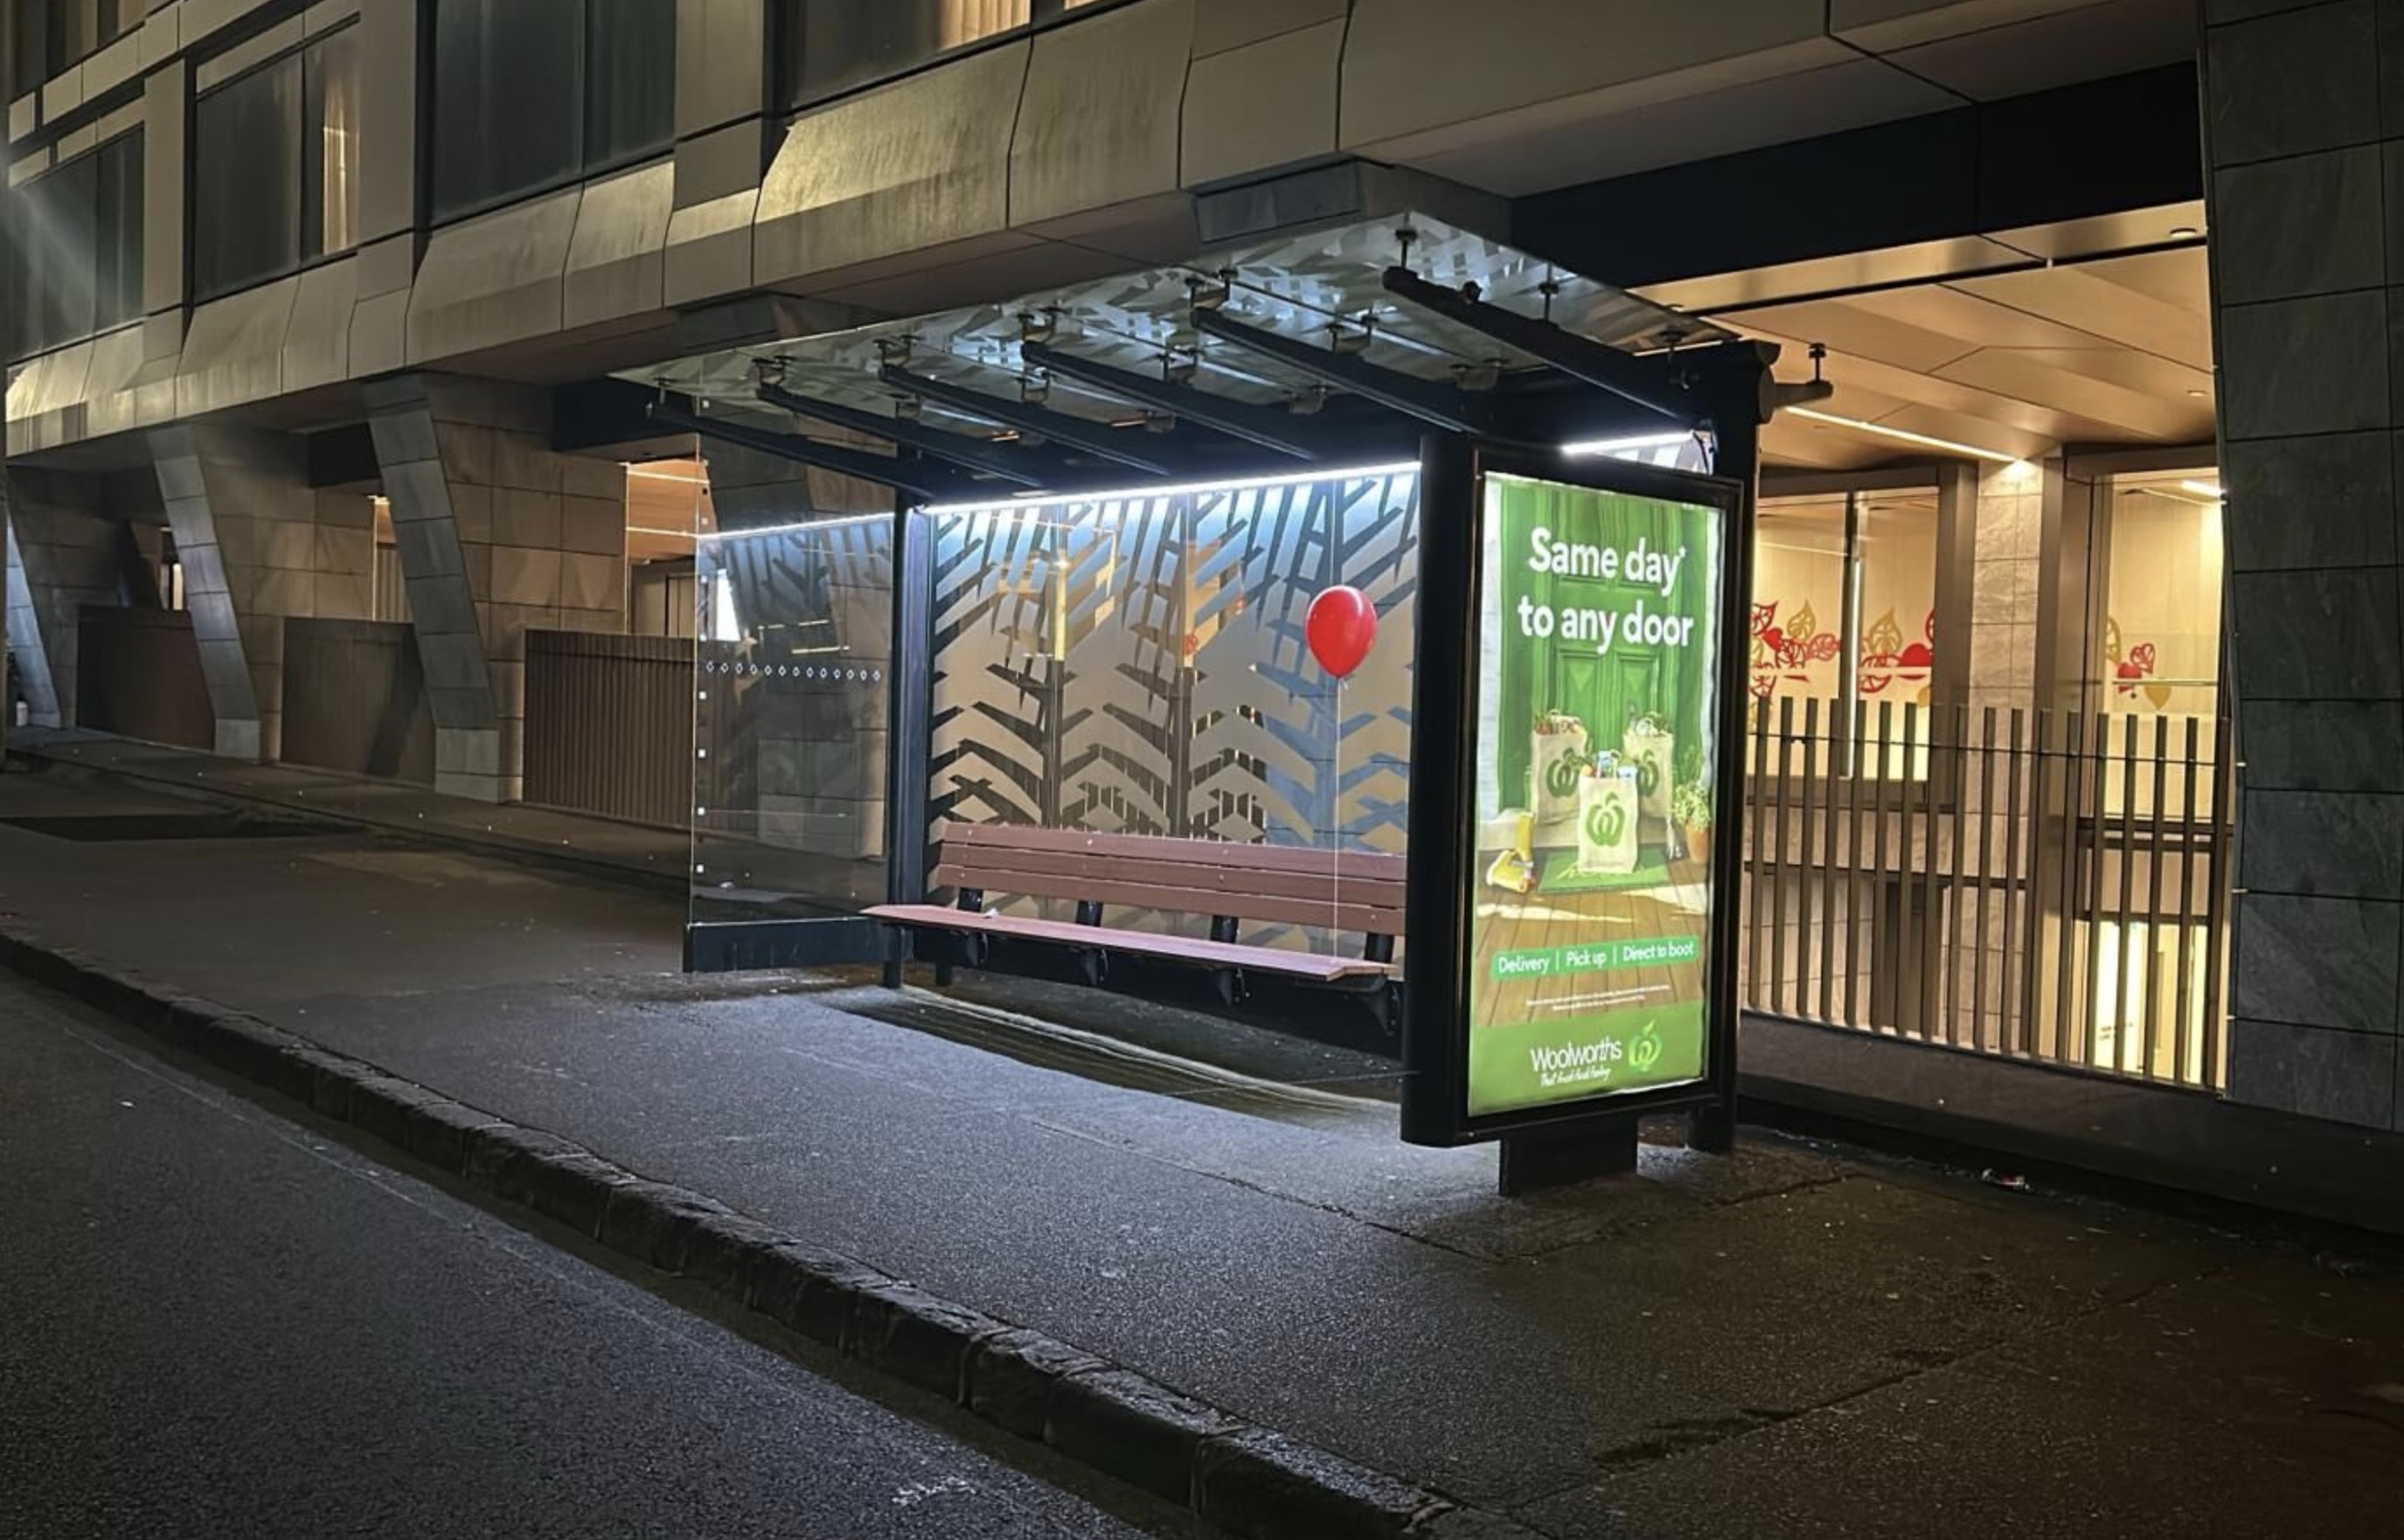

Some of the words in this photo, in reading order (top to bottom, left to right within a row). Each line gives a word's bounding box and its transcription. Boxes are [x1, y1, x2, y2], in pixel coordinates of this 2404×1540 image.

[1529, 526, 1618, 579] Same
[1518, 595, 1554, 638] to
[1561, 607, 1617, 655] any
[1622, 600, 1694, 647] door
[1498, 956, 1550, 974] Delivery
[1566, 949, 1591, 967] Pick
[1592, 953, 1607, 968] up
[1622, 944, 1655, 962] Direct
[1656, 945, 1666, 958] to
[1668, 941, 1694, 957] boot
[1531, 1036, 1622, 1072] Woolworths
